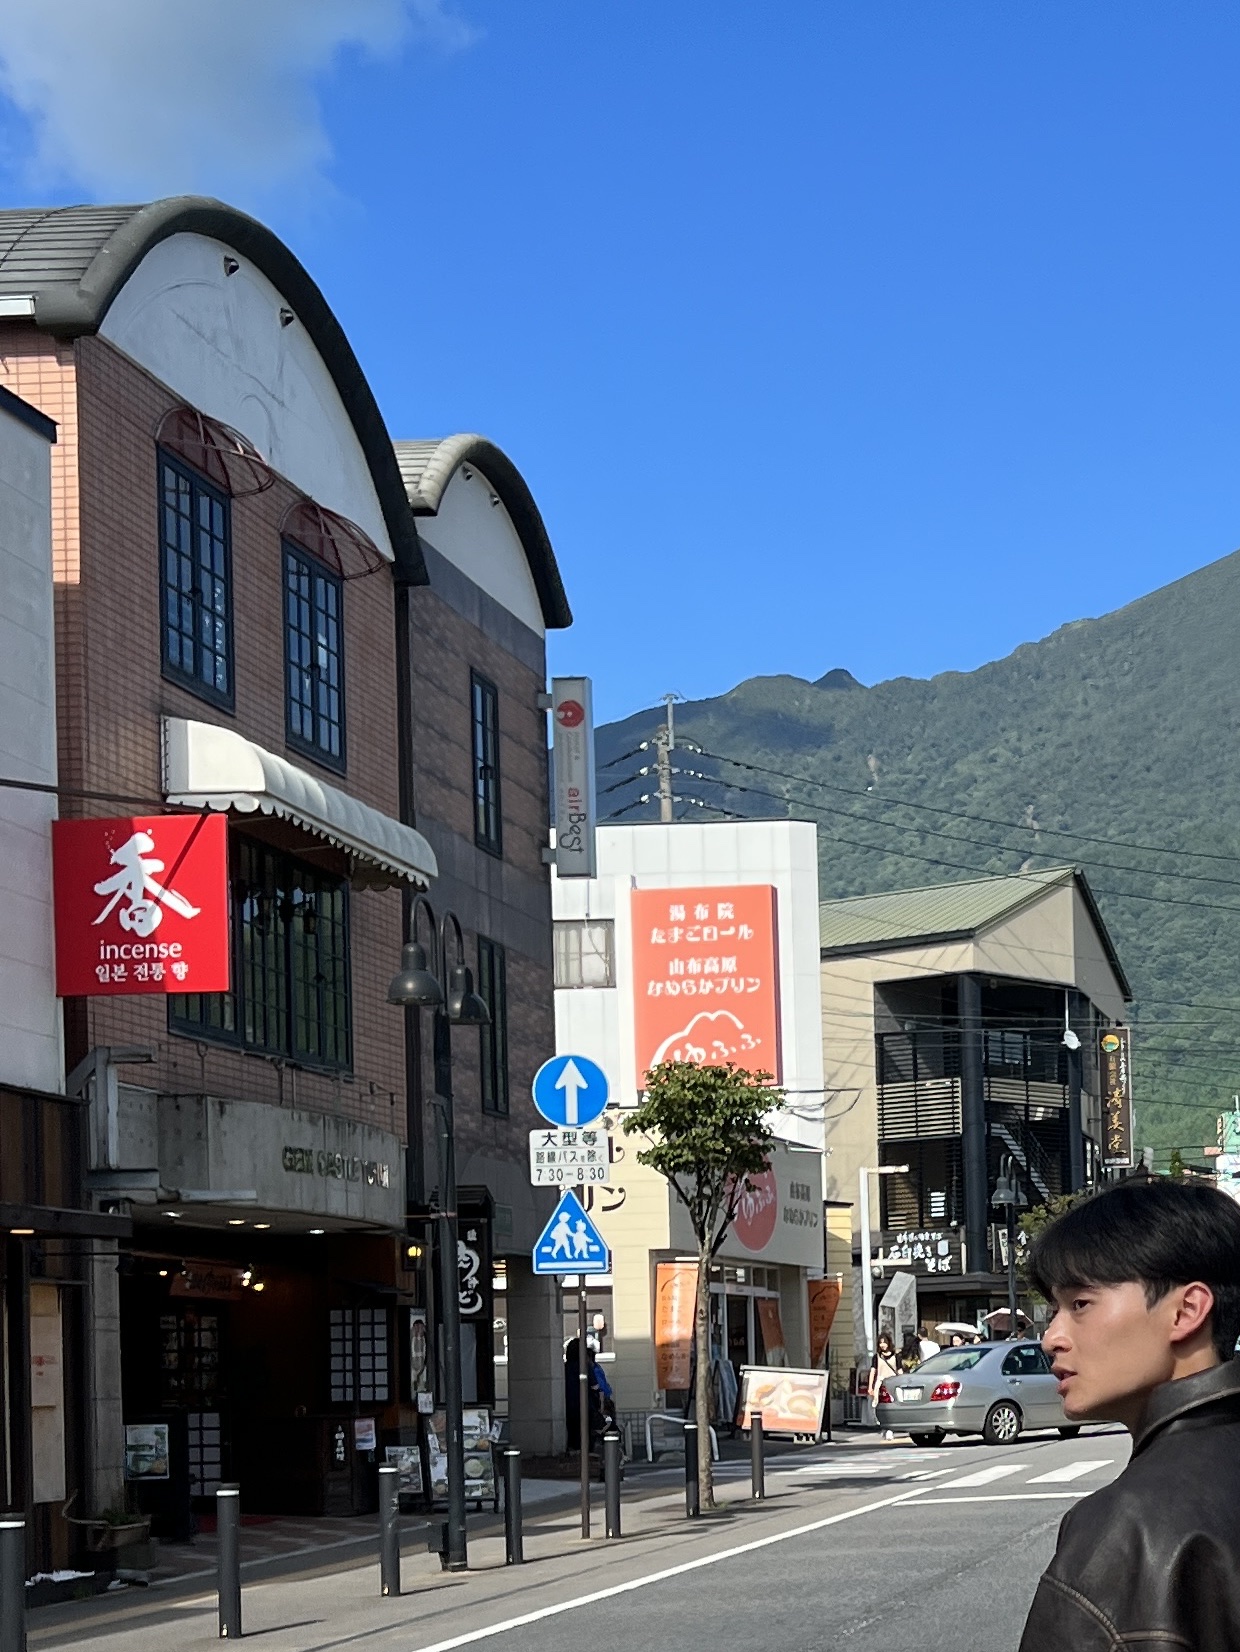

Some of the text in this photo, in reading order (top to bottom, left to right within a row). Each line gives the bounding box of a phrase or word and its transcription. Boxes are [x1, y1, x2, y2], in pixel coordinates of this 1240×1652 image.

[91, 828, 201, 938] 香
[669, 902, 735, 922] 湯布院
[651, 924, 755, 944] たまごロール
[99, 939, 183, 960] incense
[95, 963, 129, 983] 일본
[133, 962, 166, 982] 전통
[647, 976, 762, 998] なめらかプリン
[541, 1131, 598, 1147] 大型等
[535, 1149, 604, 1164] 路線バスを除く
